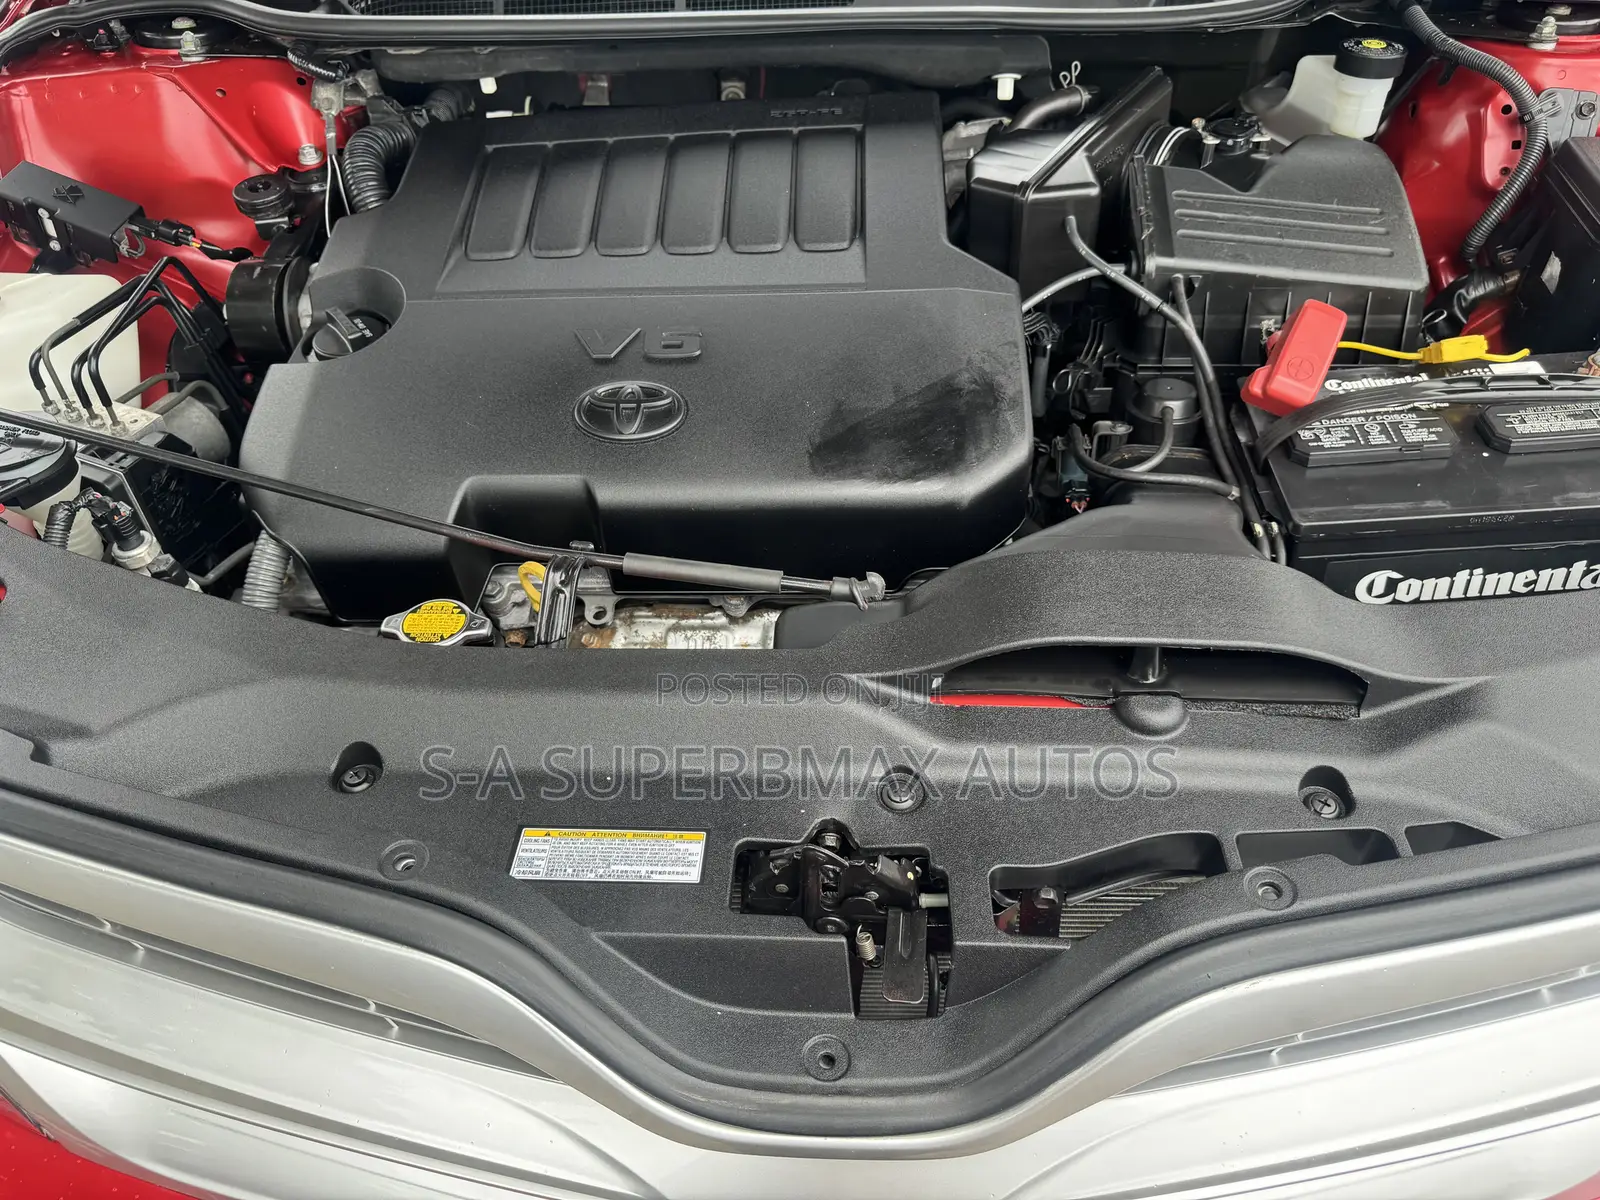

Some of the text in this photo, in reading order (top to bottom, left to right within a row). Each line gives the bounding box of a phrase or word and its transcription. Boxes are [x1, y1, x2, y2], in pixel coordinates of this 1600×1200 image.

[573, 327, 703, 359] V6
[1321, 416, 1365, 426] DANGER
[1375, 413, 1417, 422] POISON
